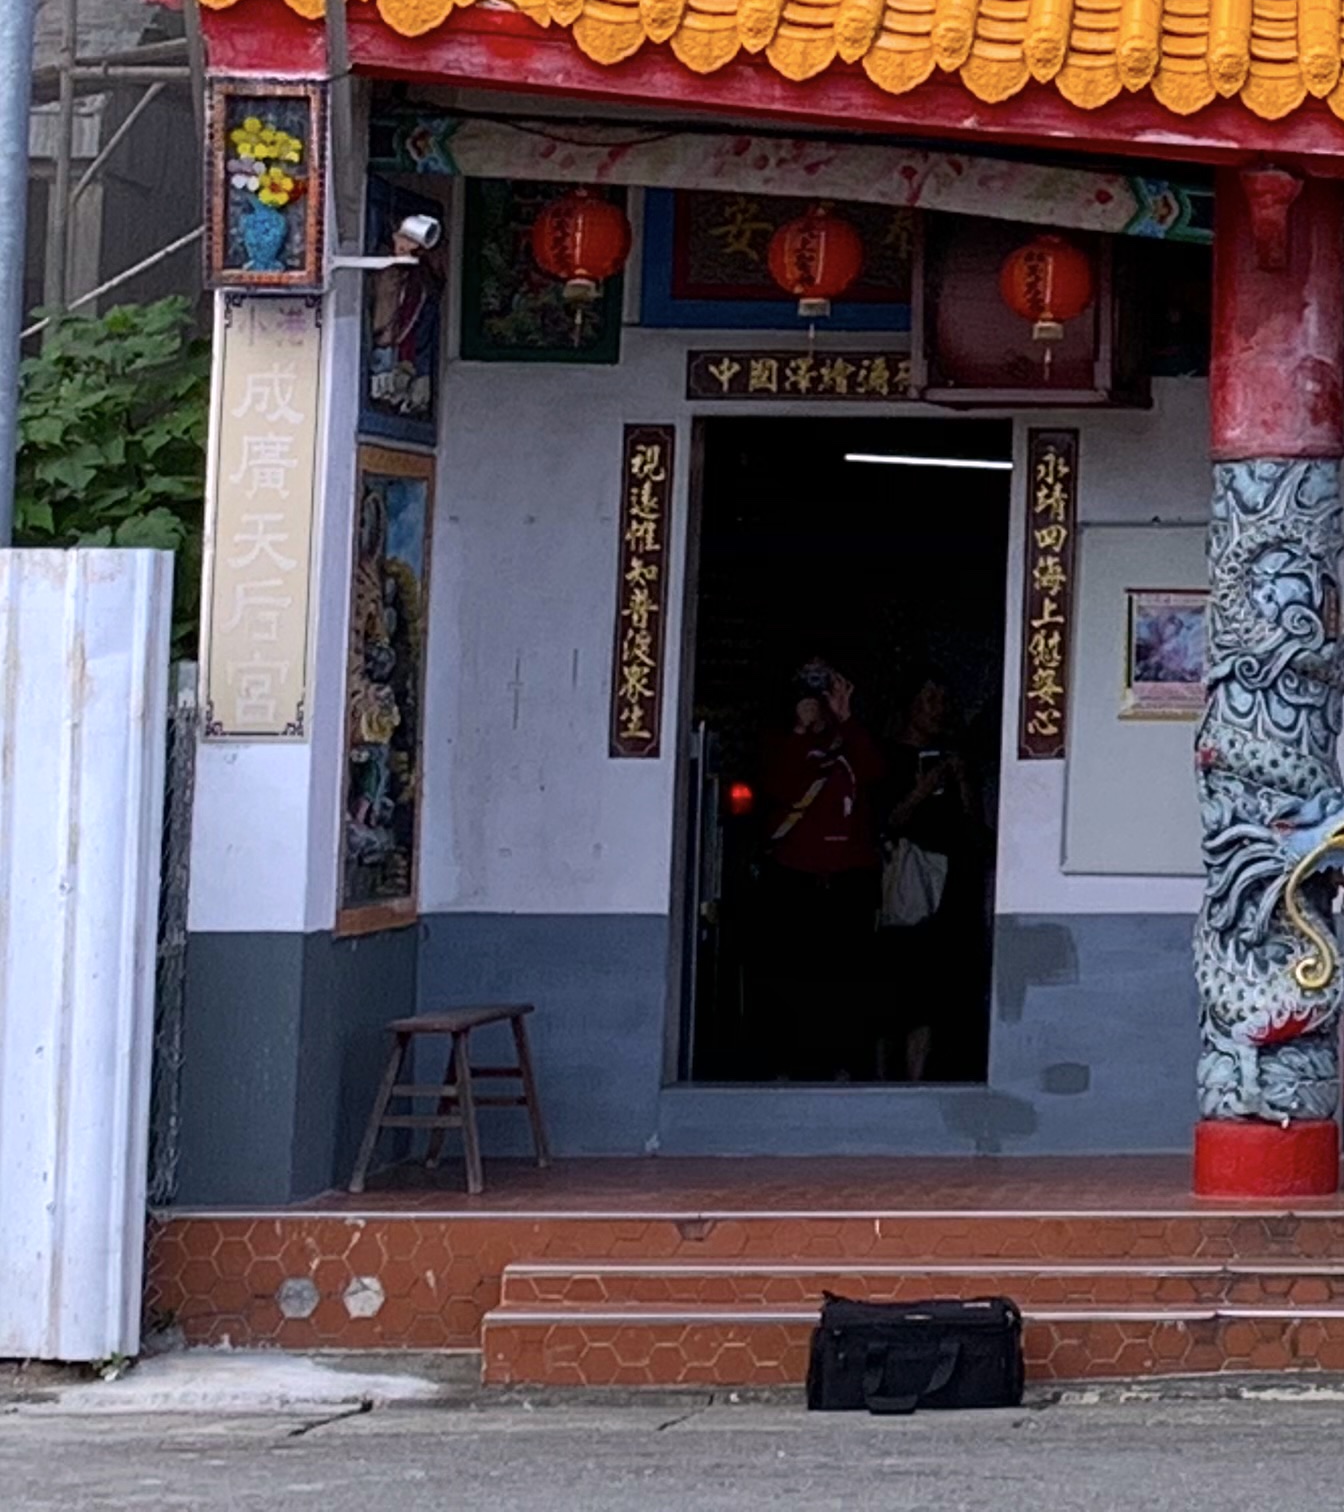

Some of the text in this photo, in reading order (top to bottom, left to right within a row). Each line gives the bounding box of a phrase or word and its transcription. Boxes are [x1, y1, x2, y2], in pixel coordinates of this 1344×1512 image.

[223, 361, 305, 728] 成廣天后宮
